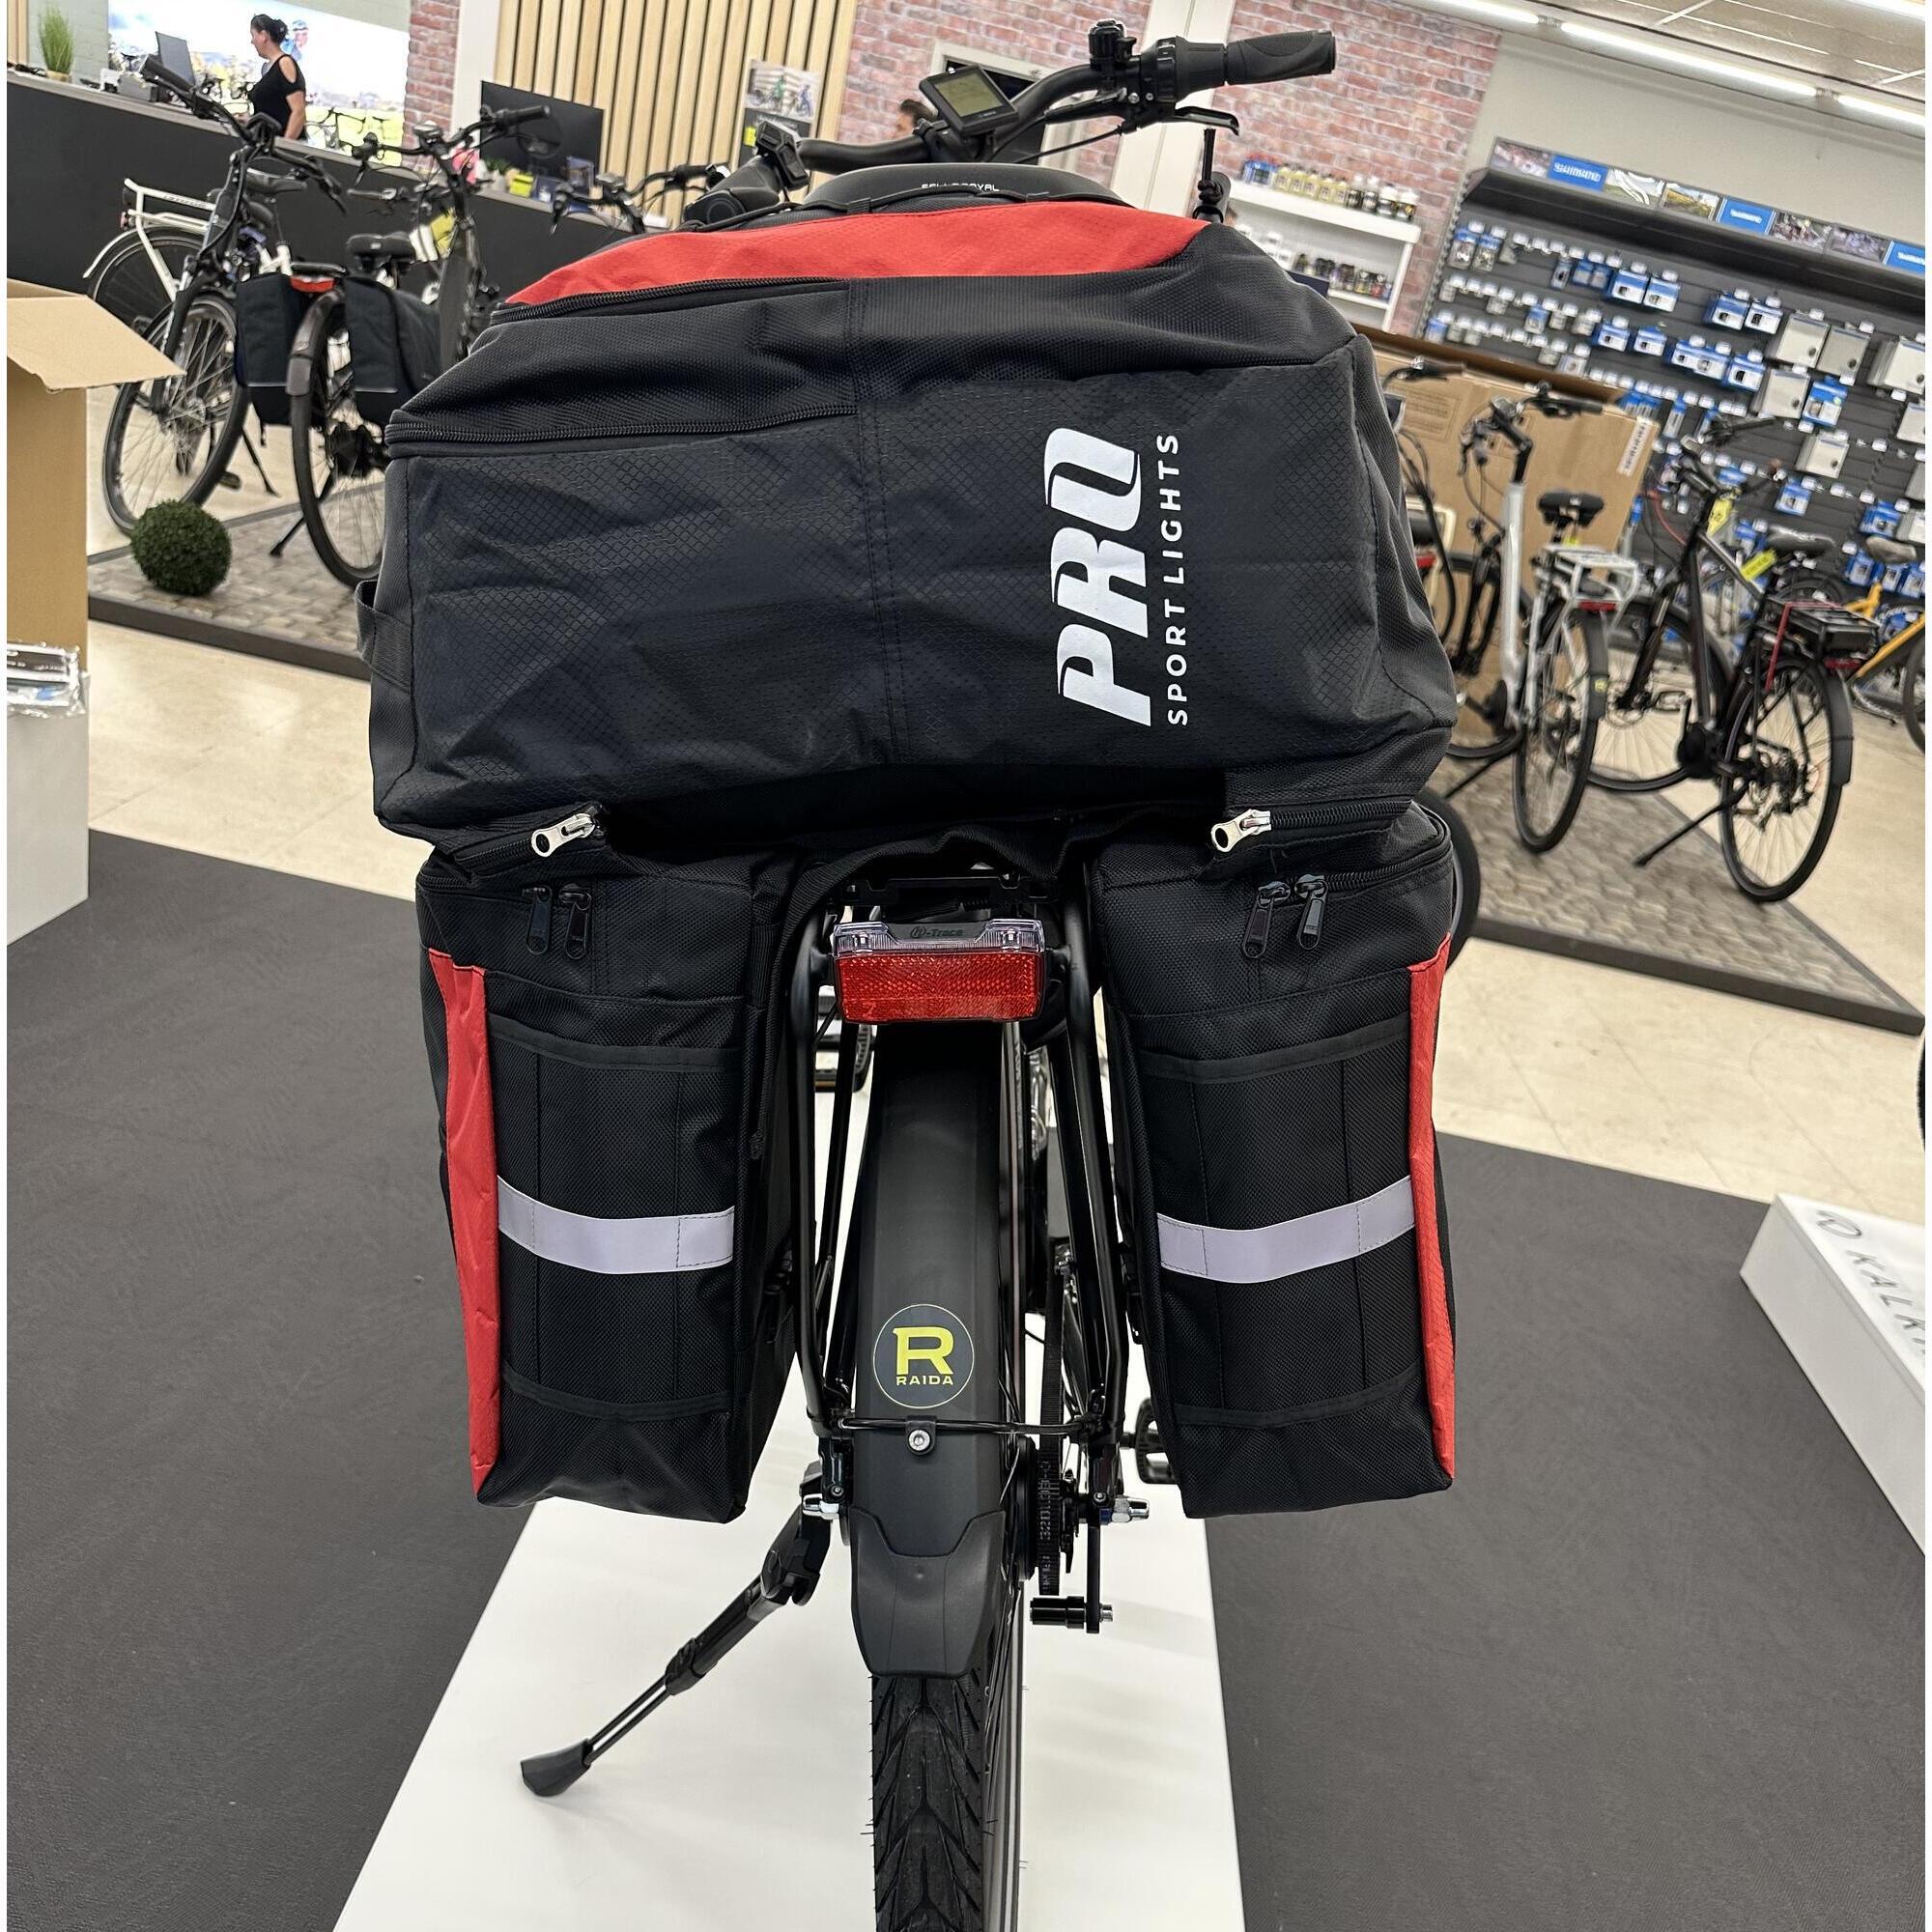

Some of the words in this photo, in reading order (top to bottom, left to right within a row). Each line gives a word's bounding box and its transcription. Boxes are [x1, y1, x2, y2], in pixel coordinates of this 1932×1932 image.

[1156, 434, 1185, 584] LIGHTS
[1044, 427, 1151, 726] PRO
[1164, 598, 1188, 726] SPORT
[892, 1326, 954, 1376] R
[895, 1376, 954, 1386] RAIDA
